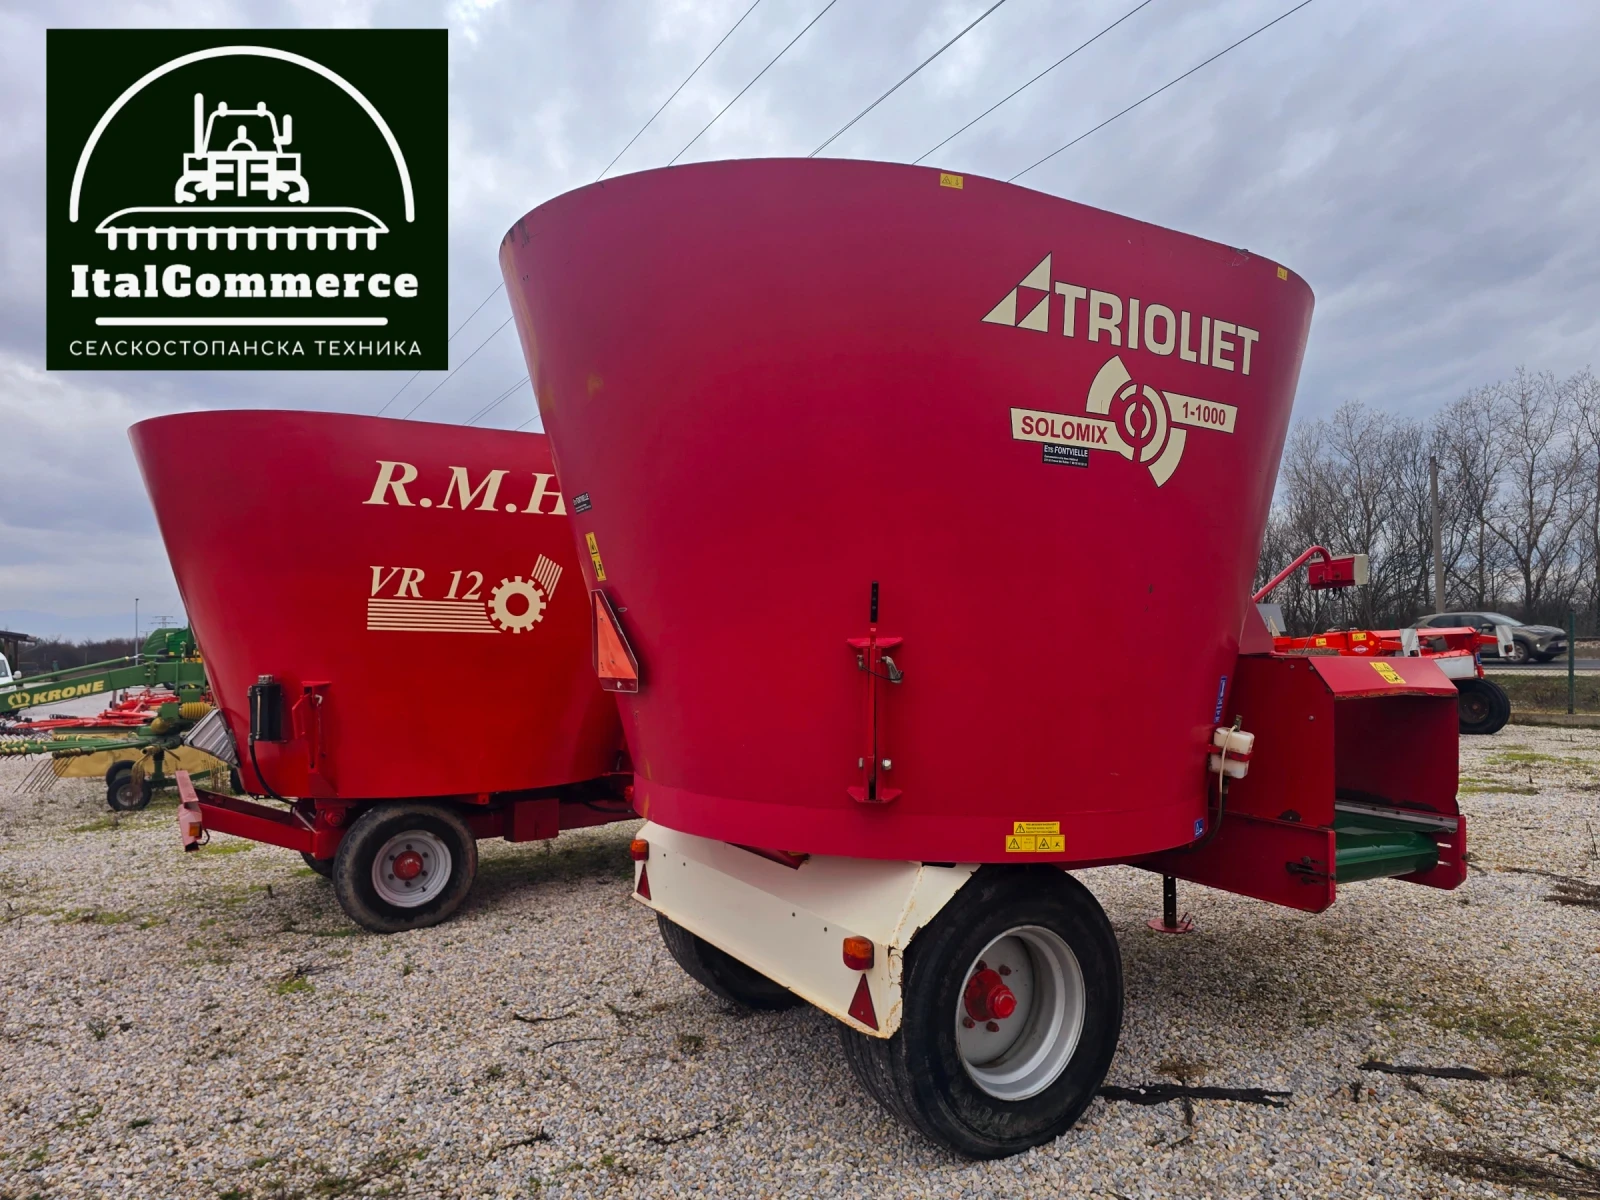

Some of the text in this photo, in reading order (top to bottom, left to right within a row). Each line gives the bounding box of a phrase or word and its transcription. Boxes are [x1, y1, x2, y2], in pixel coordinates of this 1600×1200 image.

[1054, 281, 1260, 376] TRIOLIET
[1182, 401, 1226, 426] 1-1000
[1021, 415, 1108, 445] SOLOMIX
[1054, 446, 1088, 457] FONTVIELLE
[369, 565, 484, 600] VR 12
[32, 680, 104, 703] KRONE
